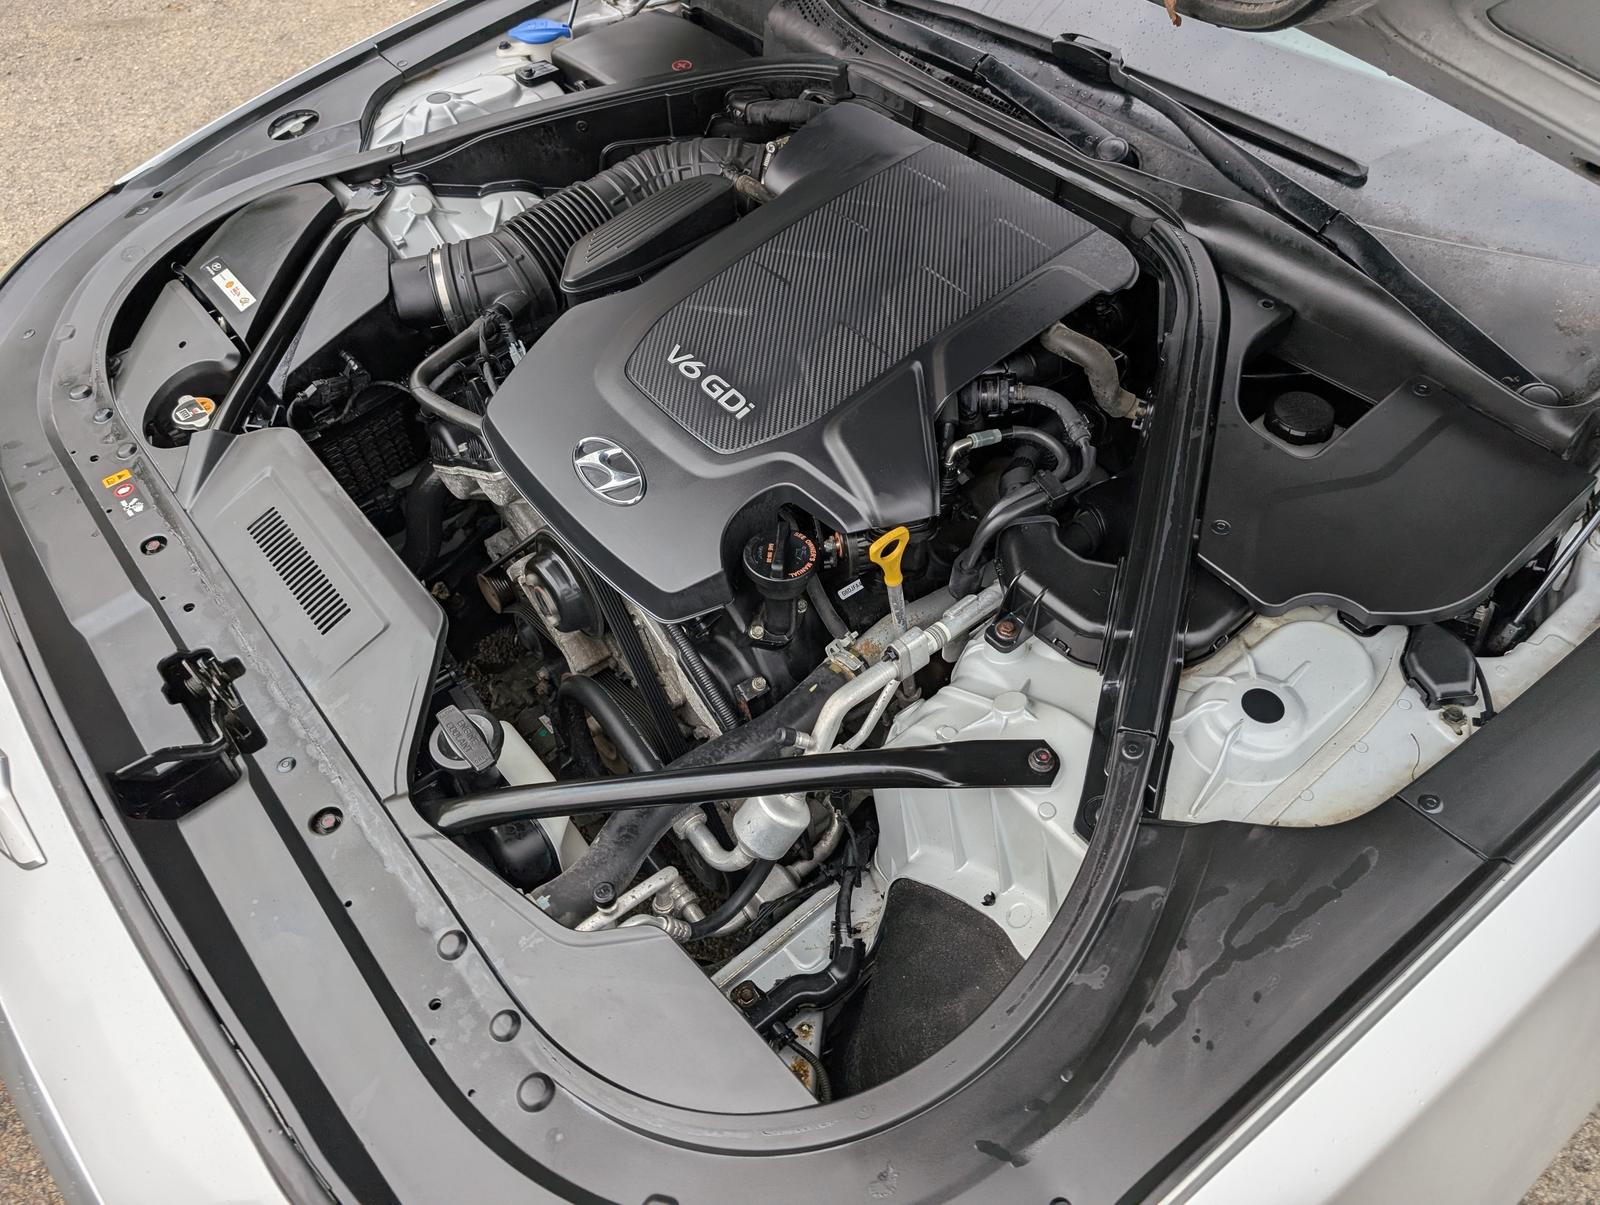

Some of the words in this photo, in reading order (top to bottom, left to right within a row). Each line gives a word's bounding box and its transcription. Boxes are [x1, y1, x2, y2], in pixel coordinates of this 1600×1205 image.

[667, 343, 706, 379] V6
[701, 374, 755, 420] GDi
[793, 531, 807, 541] SEE
[805, 539, 817, 562] OWNER'S
[788, 562, 813, 578] MANUAL
[446, 722, 474, 753] COOLANT
[456, 719, 481, 745] ENGINE
